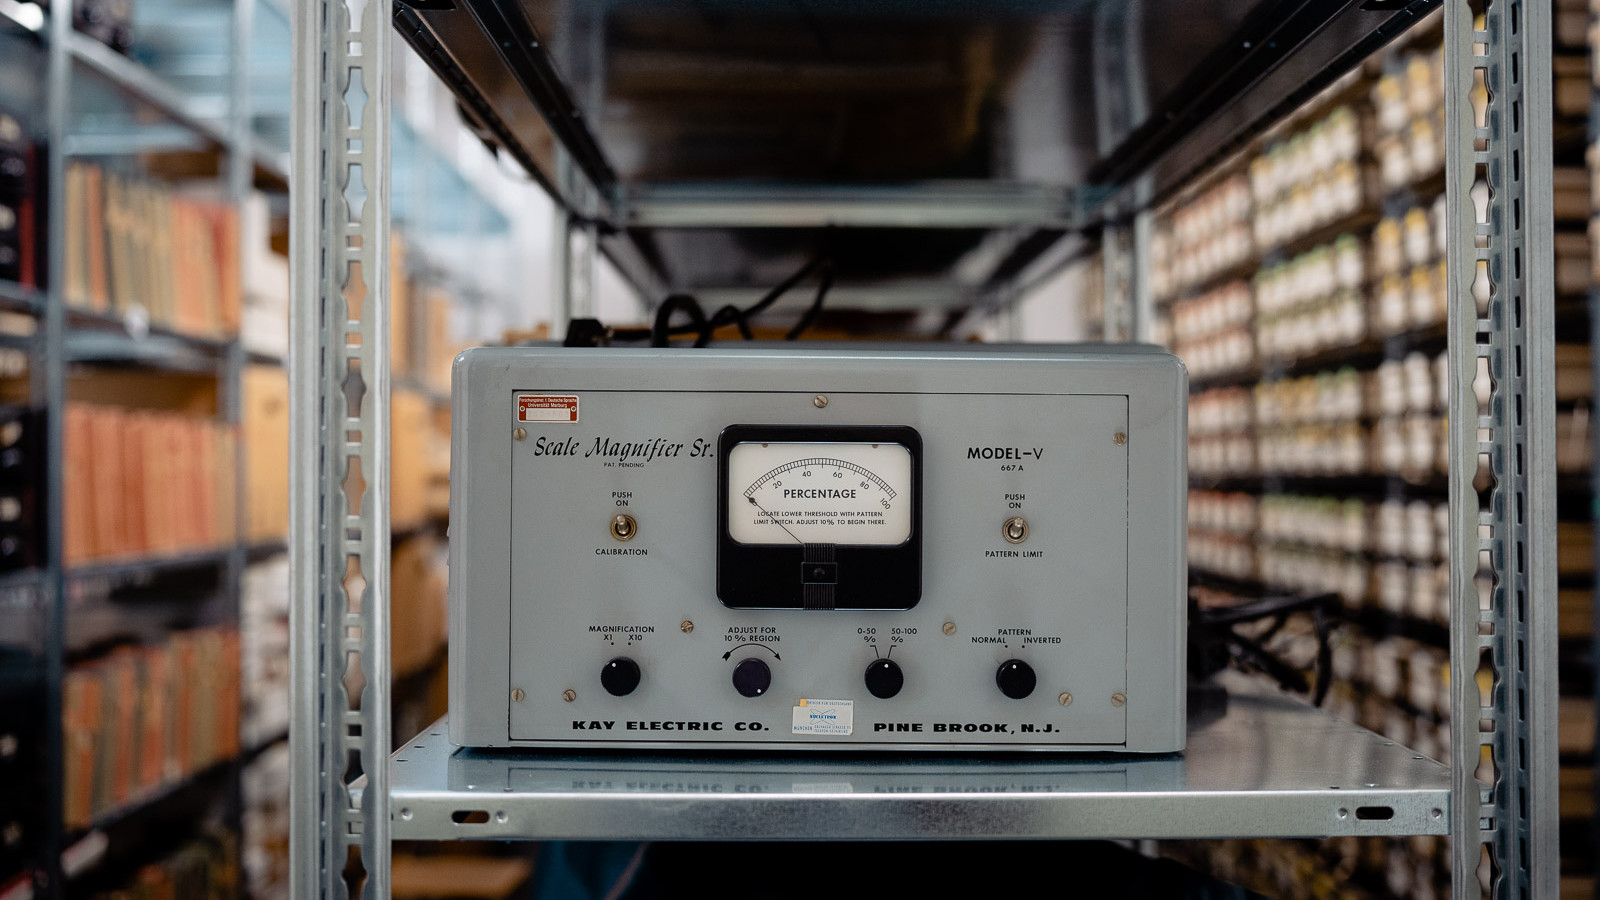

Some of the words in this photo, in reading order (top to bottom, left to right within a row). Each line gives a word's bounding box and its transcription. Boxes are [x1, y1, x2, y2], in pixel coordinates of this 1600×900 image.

[534, 436, 580, 457] Scale
[584, 436, 684, 462] Magnifier
[689, 437, 715, 458] Sr.
[772, 480, 783, 489] 20
[859, 481, 870, 490] 80
[879, 497, 891, 510] 100
[783, 489, 857, 499] PERCENTAGE
[615, 499, 629, 507] ON
[595, 548, 648, 556] CALIBRATION
[588, 625, 655, 633] MAGNIFICATION
[857, 627, 877, 635] 0-50
[891, 627, 918, 635] 50-100
[997, 628, 1032, 636] PATTERN
[572, 721, 616, 730] KAY
[626, 721, 723, 731] ELECTRIC
[734, 722, 770, 731] CO.
[874, 723, 924, 733] PINE
[933, 723, 1016, 735] BROOK,
[1021, 724, 1061, 733] N.J.
